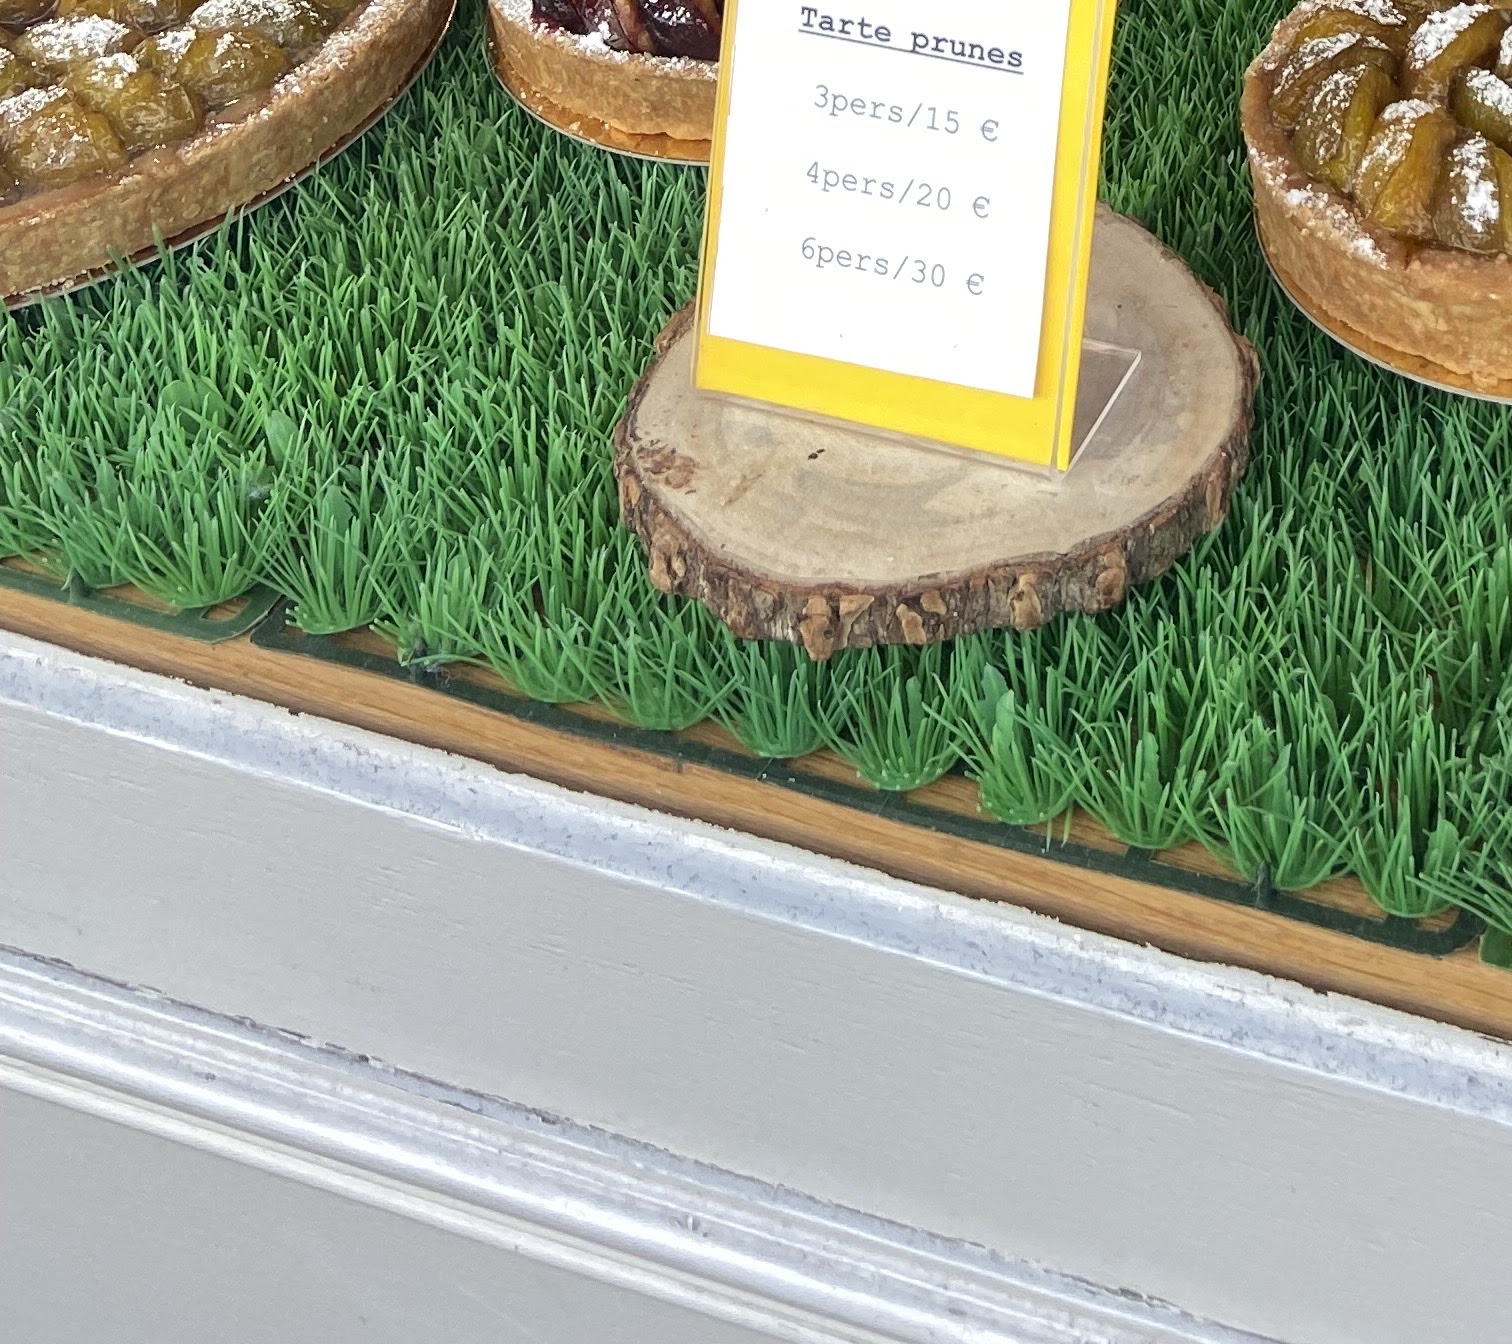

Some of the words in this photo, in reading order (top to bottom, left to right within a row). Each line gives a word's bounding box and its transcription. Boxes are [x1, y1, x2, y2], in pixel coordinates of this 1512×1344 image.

[801, 6, 892, 43] Tarte
[910, 30, 1024, 69] prunes
[813, 84, 960, 135] 3pers/15
[979, 118, 999, 142] €
[806, 160, 951, 211] 4pers/20
[972, 195, 990, 219] €
[801, 236, 946, 288] 6pers/30
[966, 272, 985, 296] €
